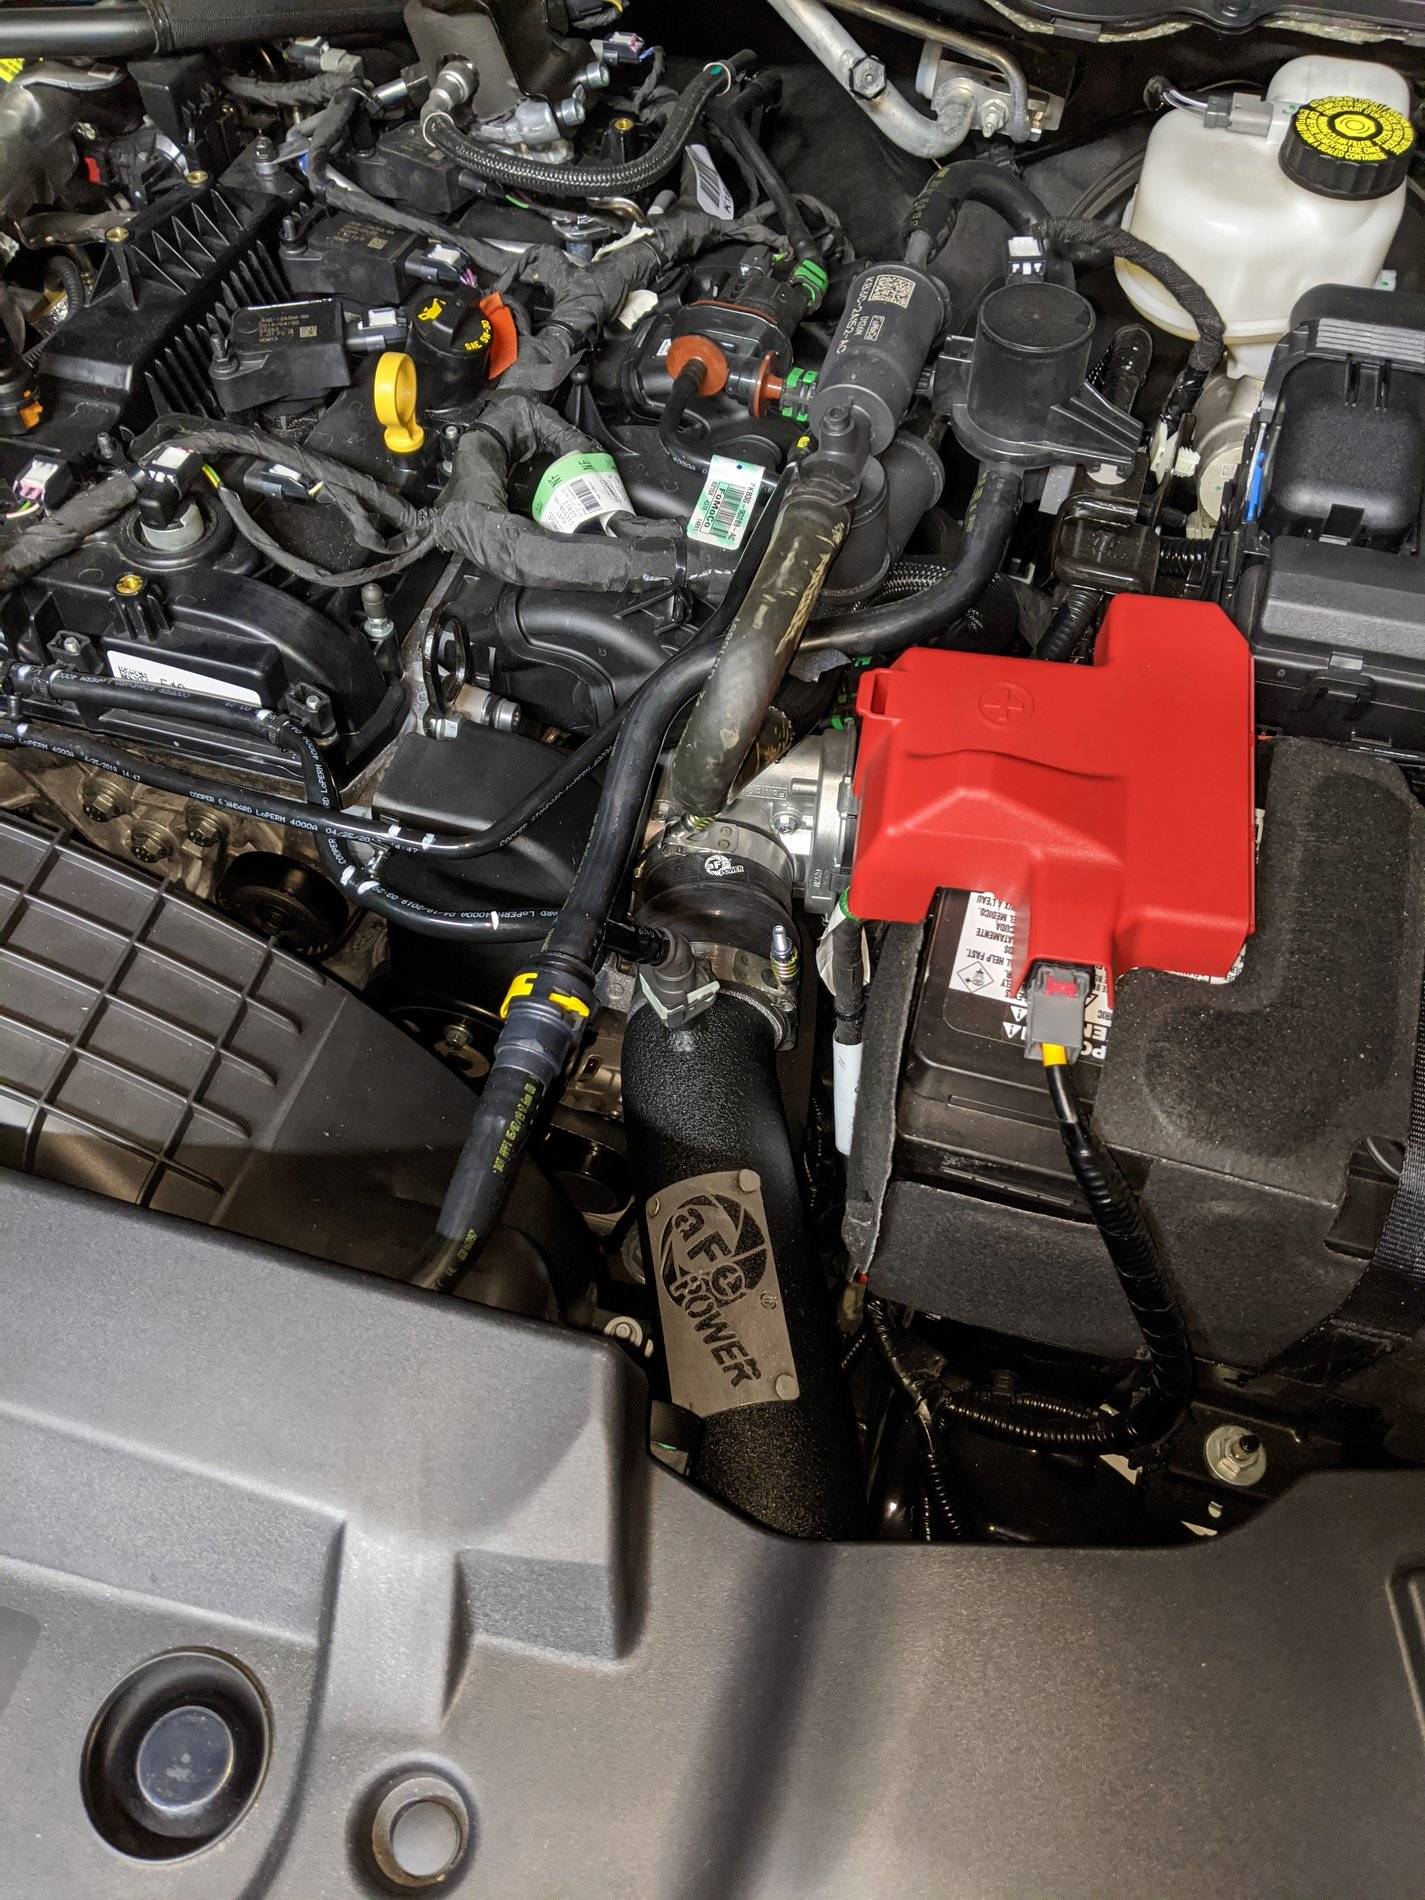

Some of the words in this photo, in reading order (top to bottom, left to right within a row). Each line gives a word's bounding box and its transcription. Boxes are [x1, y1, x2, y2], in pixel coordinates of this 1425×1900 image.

[1344, 152, 1387, 161] CONTAINER
[464, 340, 483, 350] SAE
[704, 486, 727, 529] FoMoCo
[314, 763, 329, 795] LoPERM
[189, 789, 216, 804] COOPER
[255, 808, 286, 823] LoPERM
[289, 817, 319, 832] 4000A
[719, 864, 745, 877] POWER
[966, 947, 986, 961] FAST.
[986, 953, 1006, 966] HELP
[672, 1274, 763, 1388] POWER
